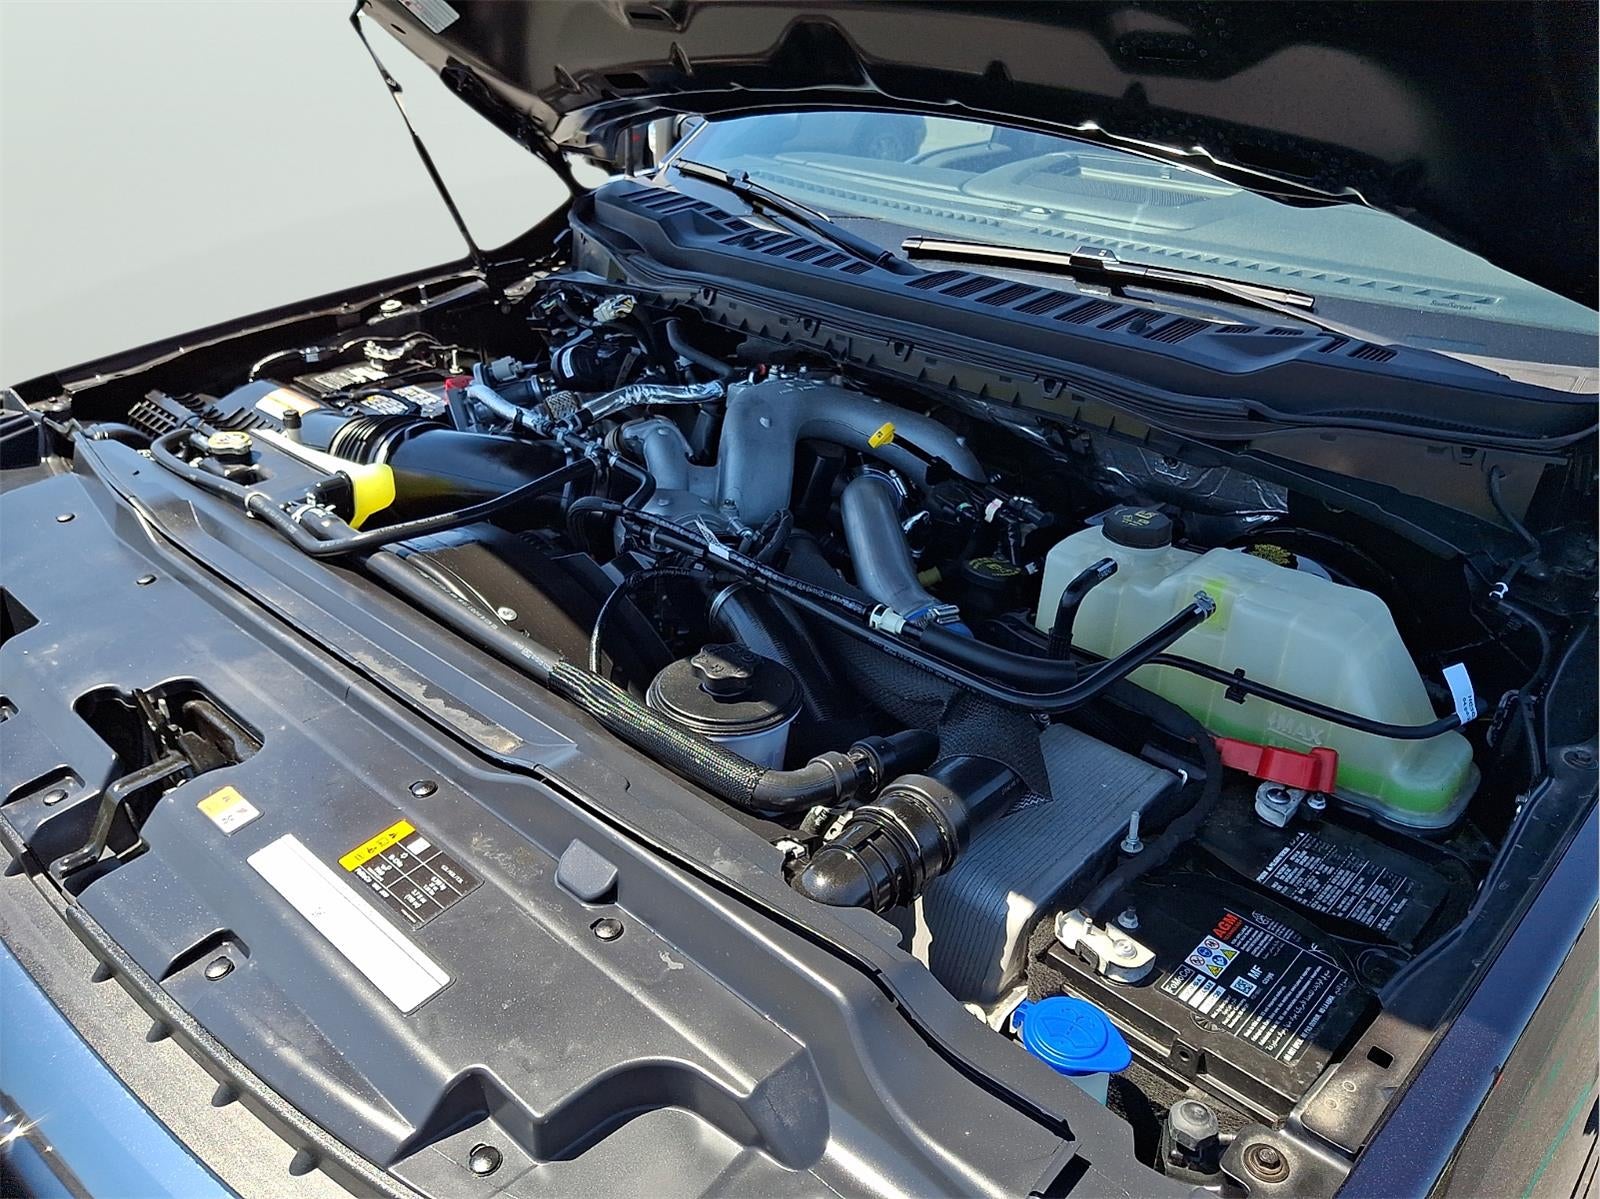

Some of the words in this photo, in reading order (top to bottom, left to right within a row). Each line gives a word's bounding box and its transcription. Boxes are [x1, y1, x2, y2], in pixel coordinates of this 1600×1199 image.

[1212, 913, 1238, 938] AGM
[1165, 966, 1191, 993] FoMoCo
[1247, 964, 1263, 980] MF
